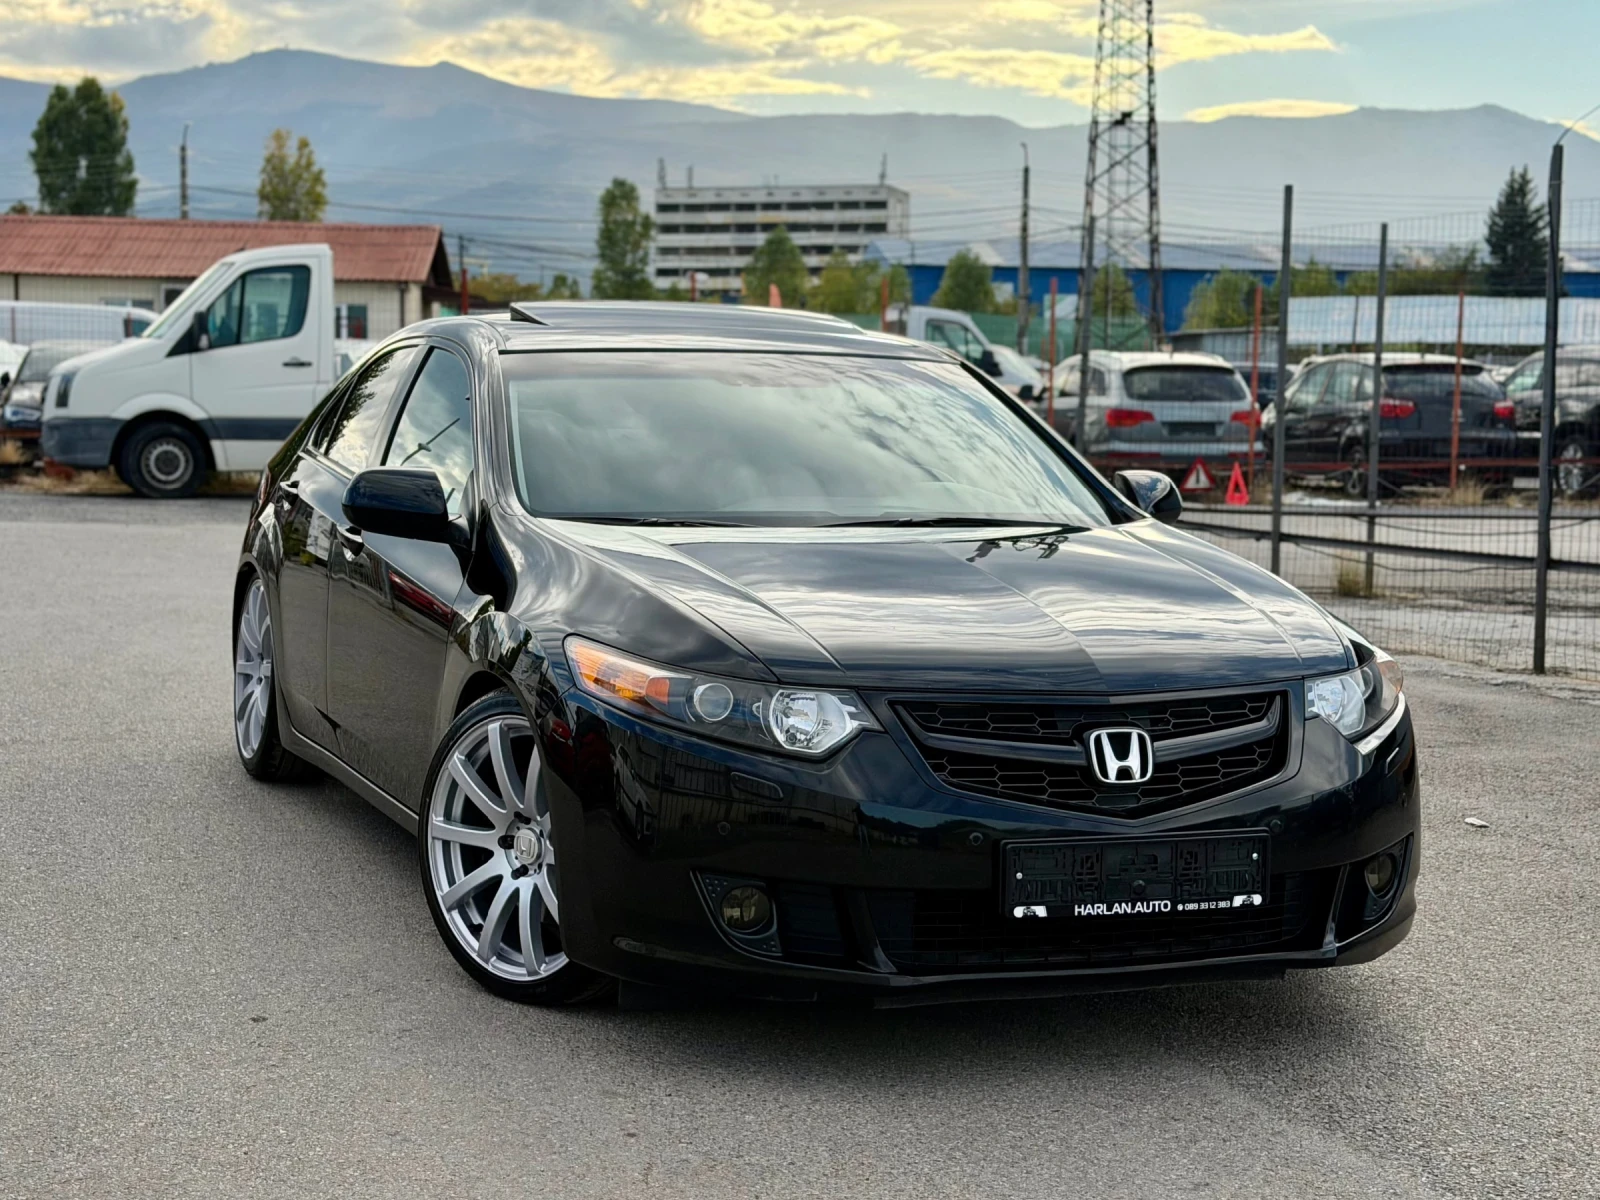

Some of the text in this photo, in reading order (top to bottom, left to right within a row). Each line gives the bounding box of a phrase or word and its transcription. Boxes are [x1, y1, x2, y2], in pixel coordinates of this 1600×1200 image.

[1074, 900, 1172, 916] HARLAN.AUTO
[1184, 902, 1199, 911] 089
[1199, 902, 1209, 911] 33
[1209, 901, 1217, 910] 12
